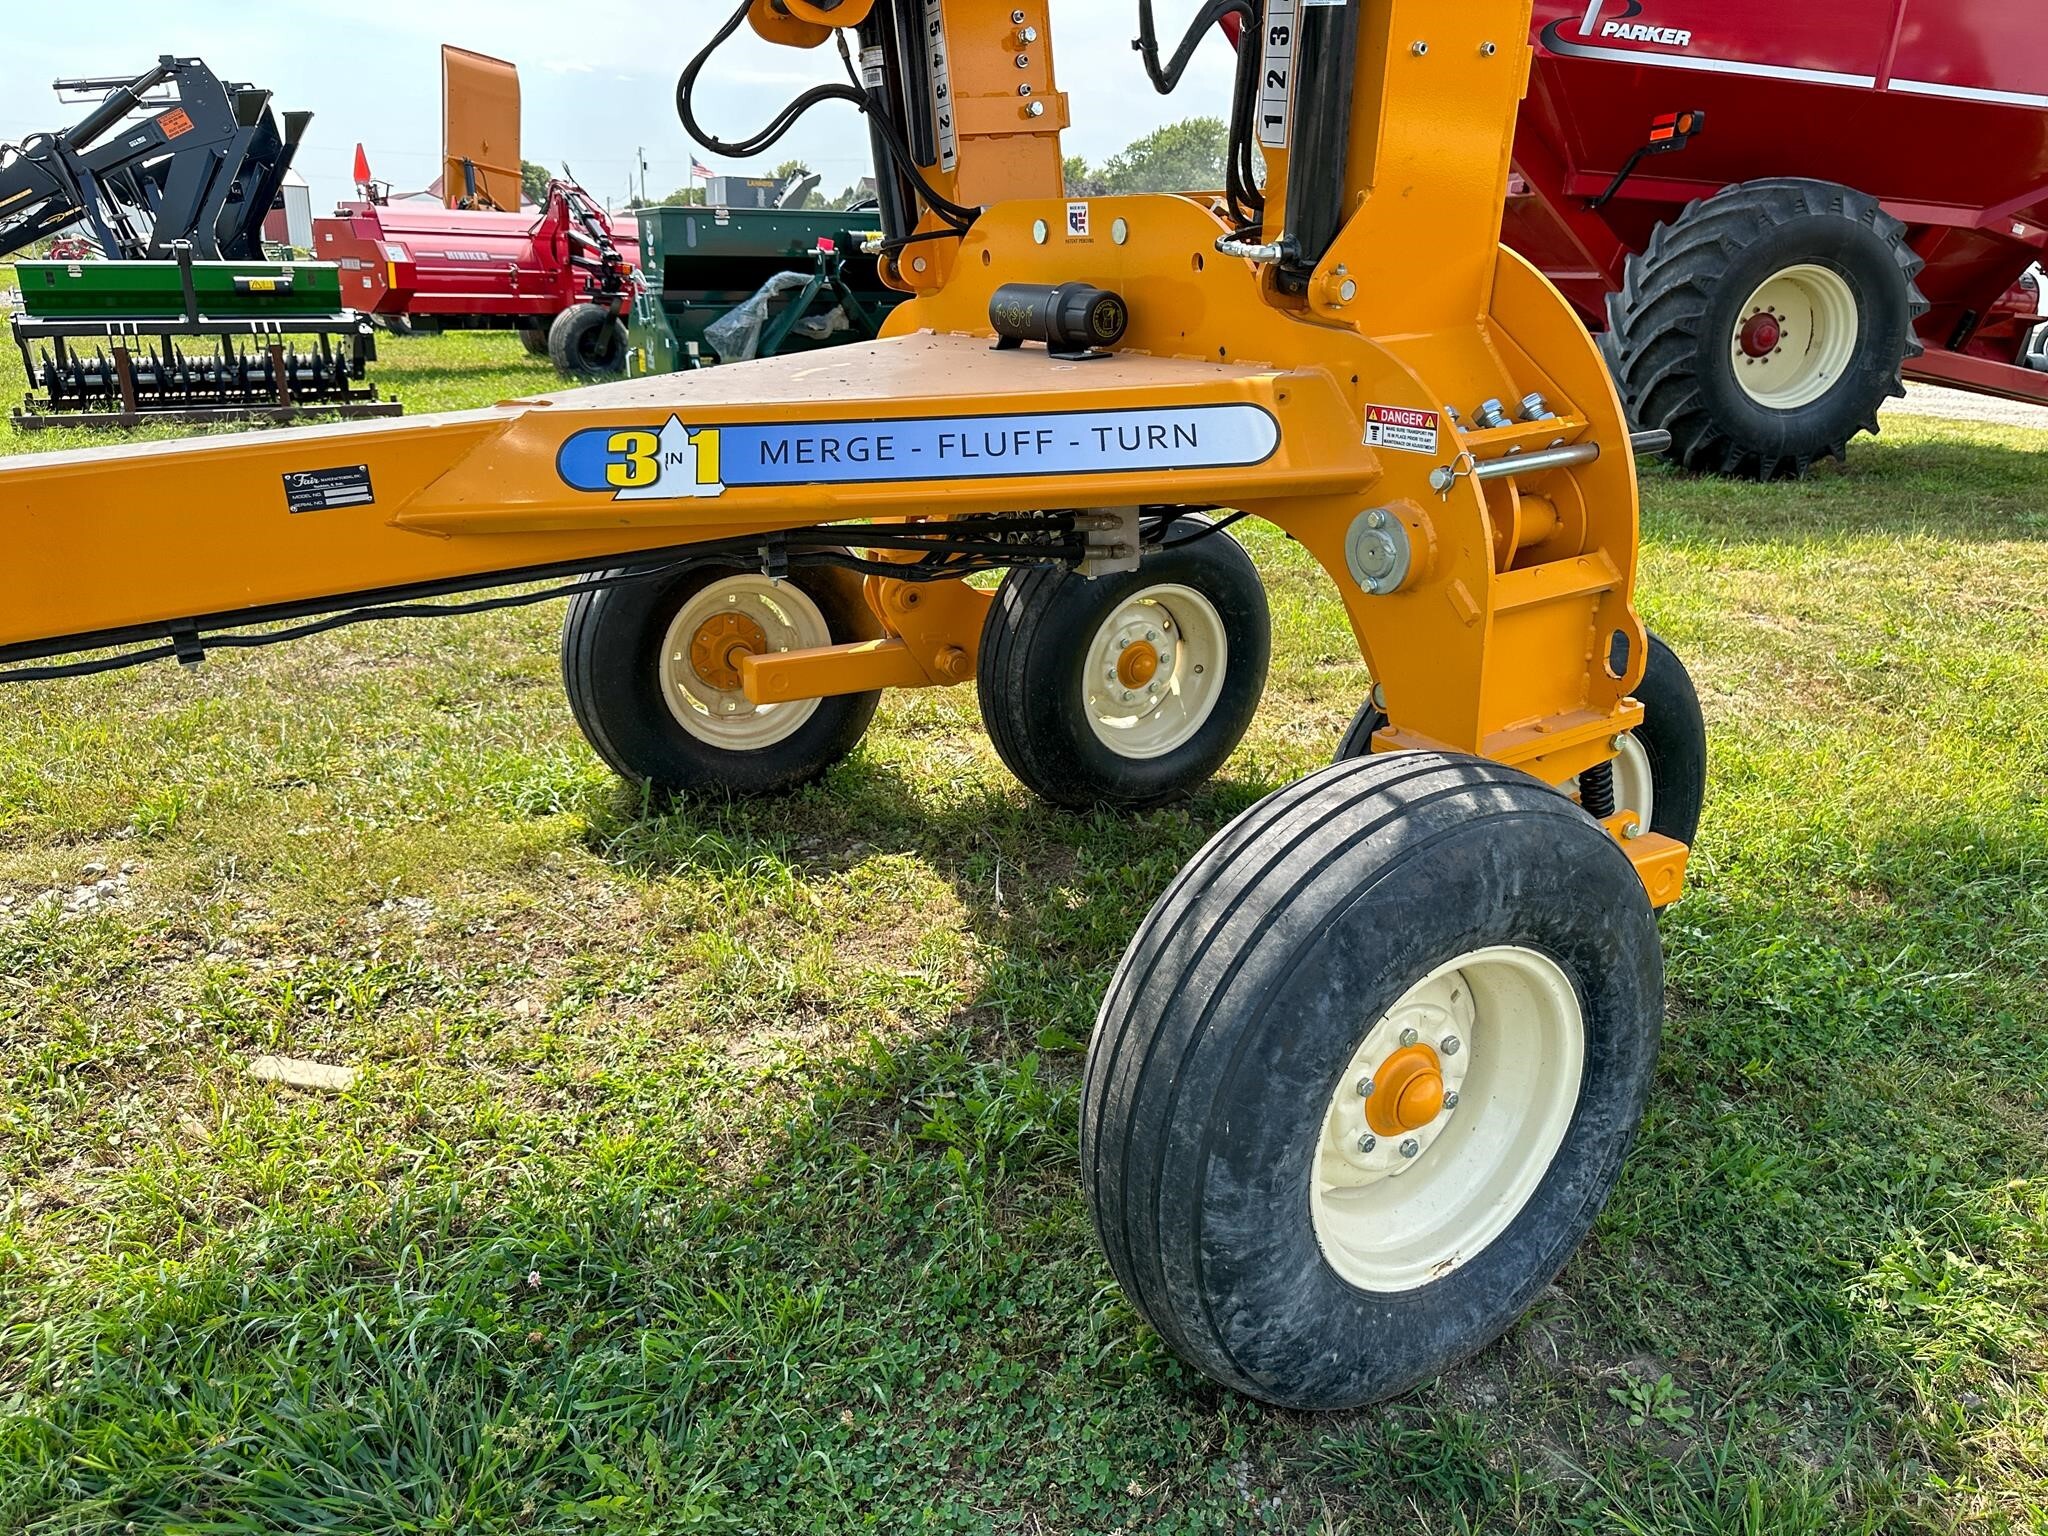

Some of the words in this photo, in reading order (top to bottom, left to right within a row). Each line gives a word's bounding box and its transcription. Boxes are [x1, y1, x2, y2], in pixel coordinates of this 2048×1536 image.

[929, 20, 941, 37] 5
[1270, 26, 1290, 46] 3
[1601, 21, 1691, 46] PARKER
[933, 53, 945, 69] 4
[1266, 69, 1286, 89] 2
[936, 83, 947, 99] 3
[939, 114, 951, 130] 2
[1264, 115, 1283, 128] 1
[942, 147, 954, 159] 1
[1381, 409, 1423, 426] DANGER
[1406, 428, 1427, 436] TRANSPORT
[605, 430, 662, 488] 3
[664, 451, 684, 466] IN
[686, 428, 721, 485] 1
[759, 435, 895, 466] MERGE
[938, 429, 1053, 460] FLUFF
[1092, 422, 1199, 452] TURN
[293, 473, 320, 488] Fair
